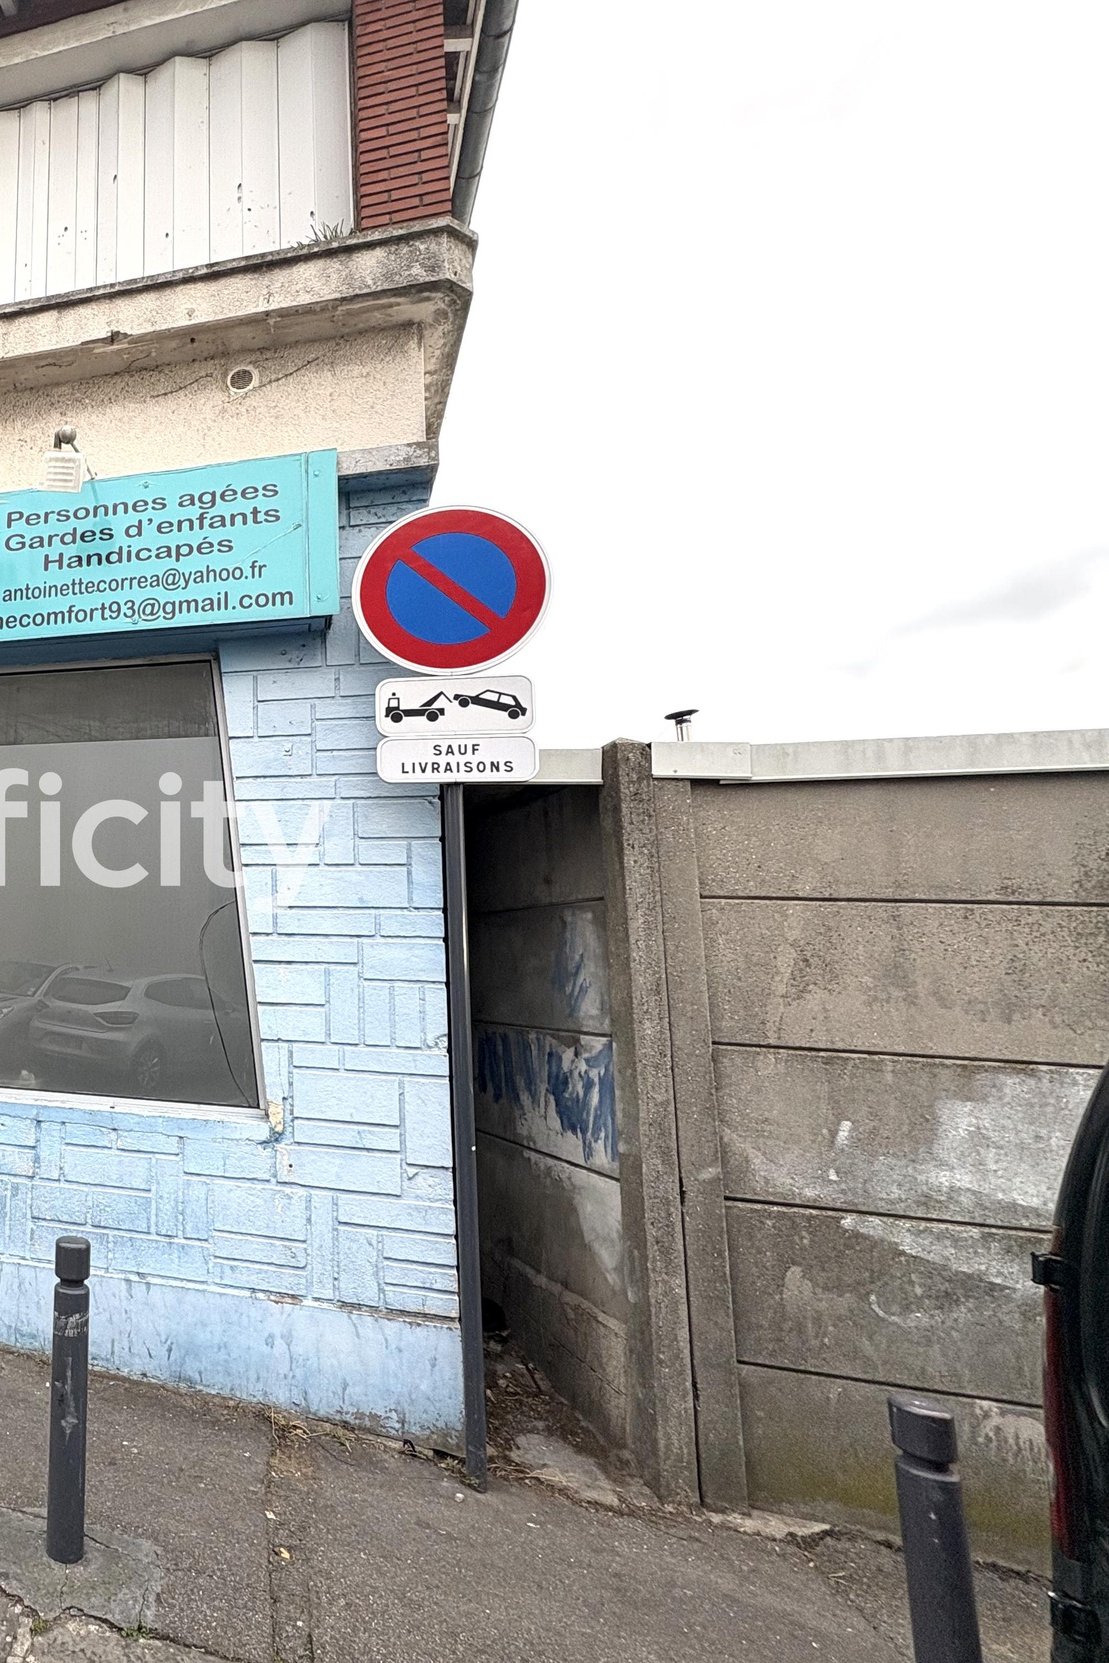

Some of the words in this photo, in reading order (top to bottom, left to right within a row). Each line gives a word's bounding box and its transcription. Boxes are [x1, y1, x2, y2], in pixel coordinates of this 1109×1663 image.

[6, 494, 168, 529] Personnes
[177, 481, 279, 510] agées
[4, 526, 115, 552] Gardes
[124, 505, 282, 540] d'enfants
[43, 536, 235, 572] Handicapés
[401, 760, 514, 774] LIVRAISONS
[433, 743, 481, 757] SAUF
